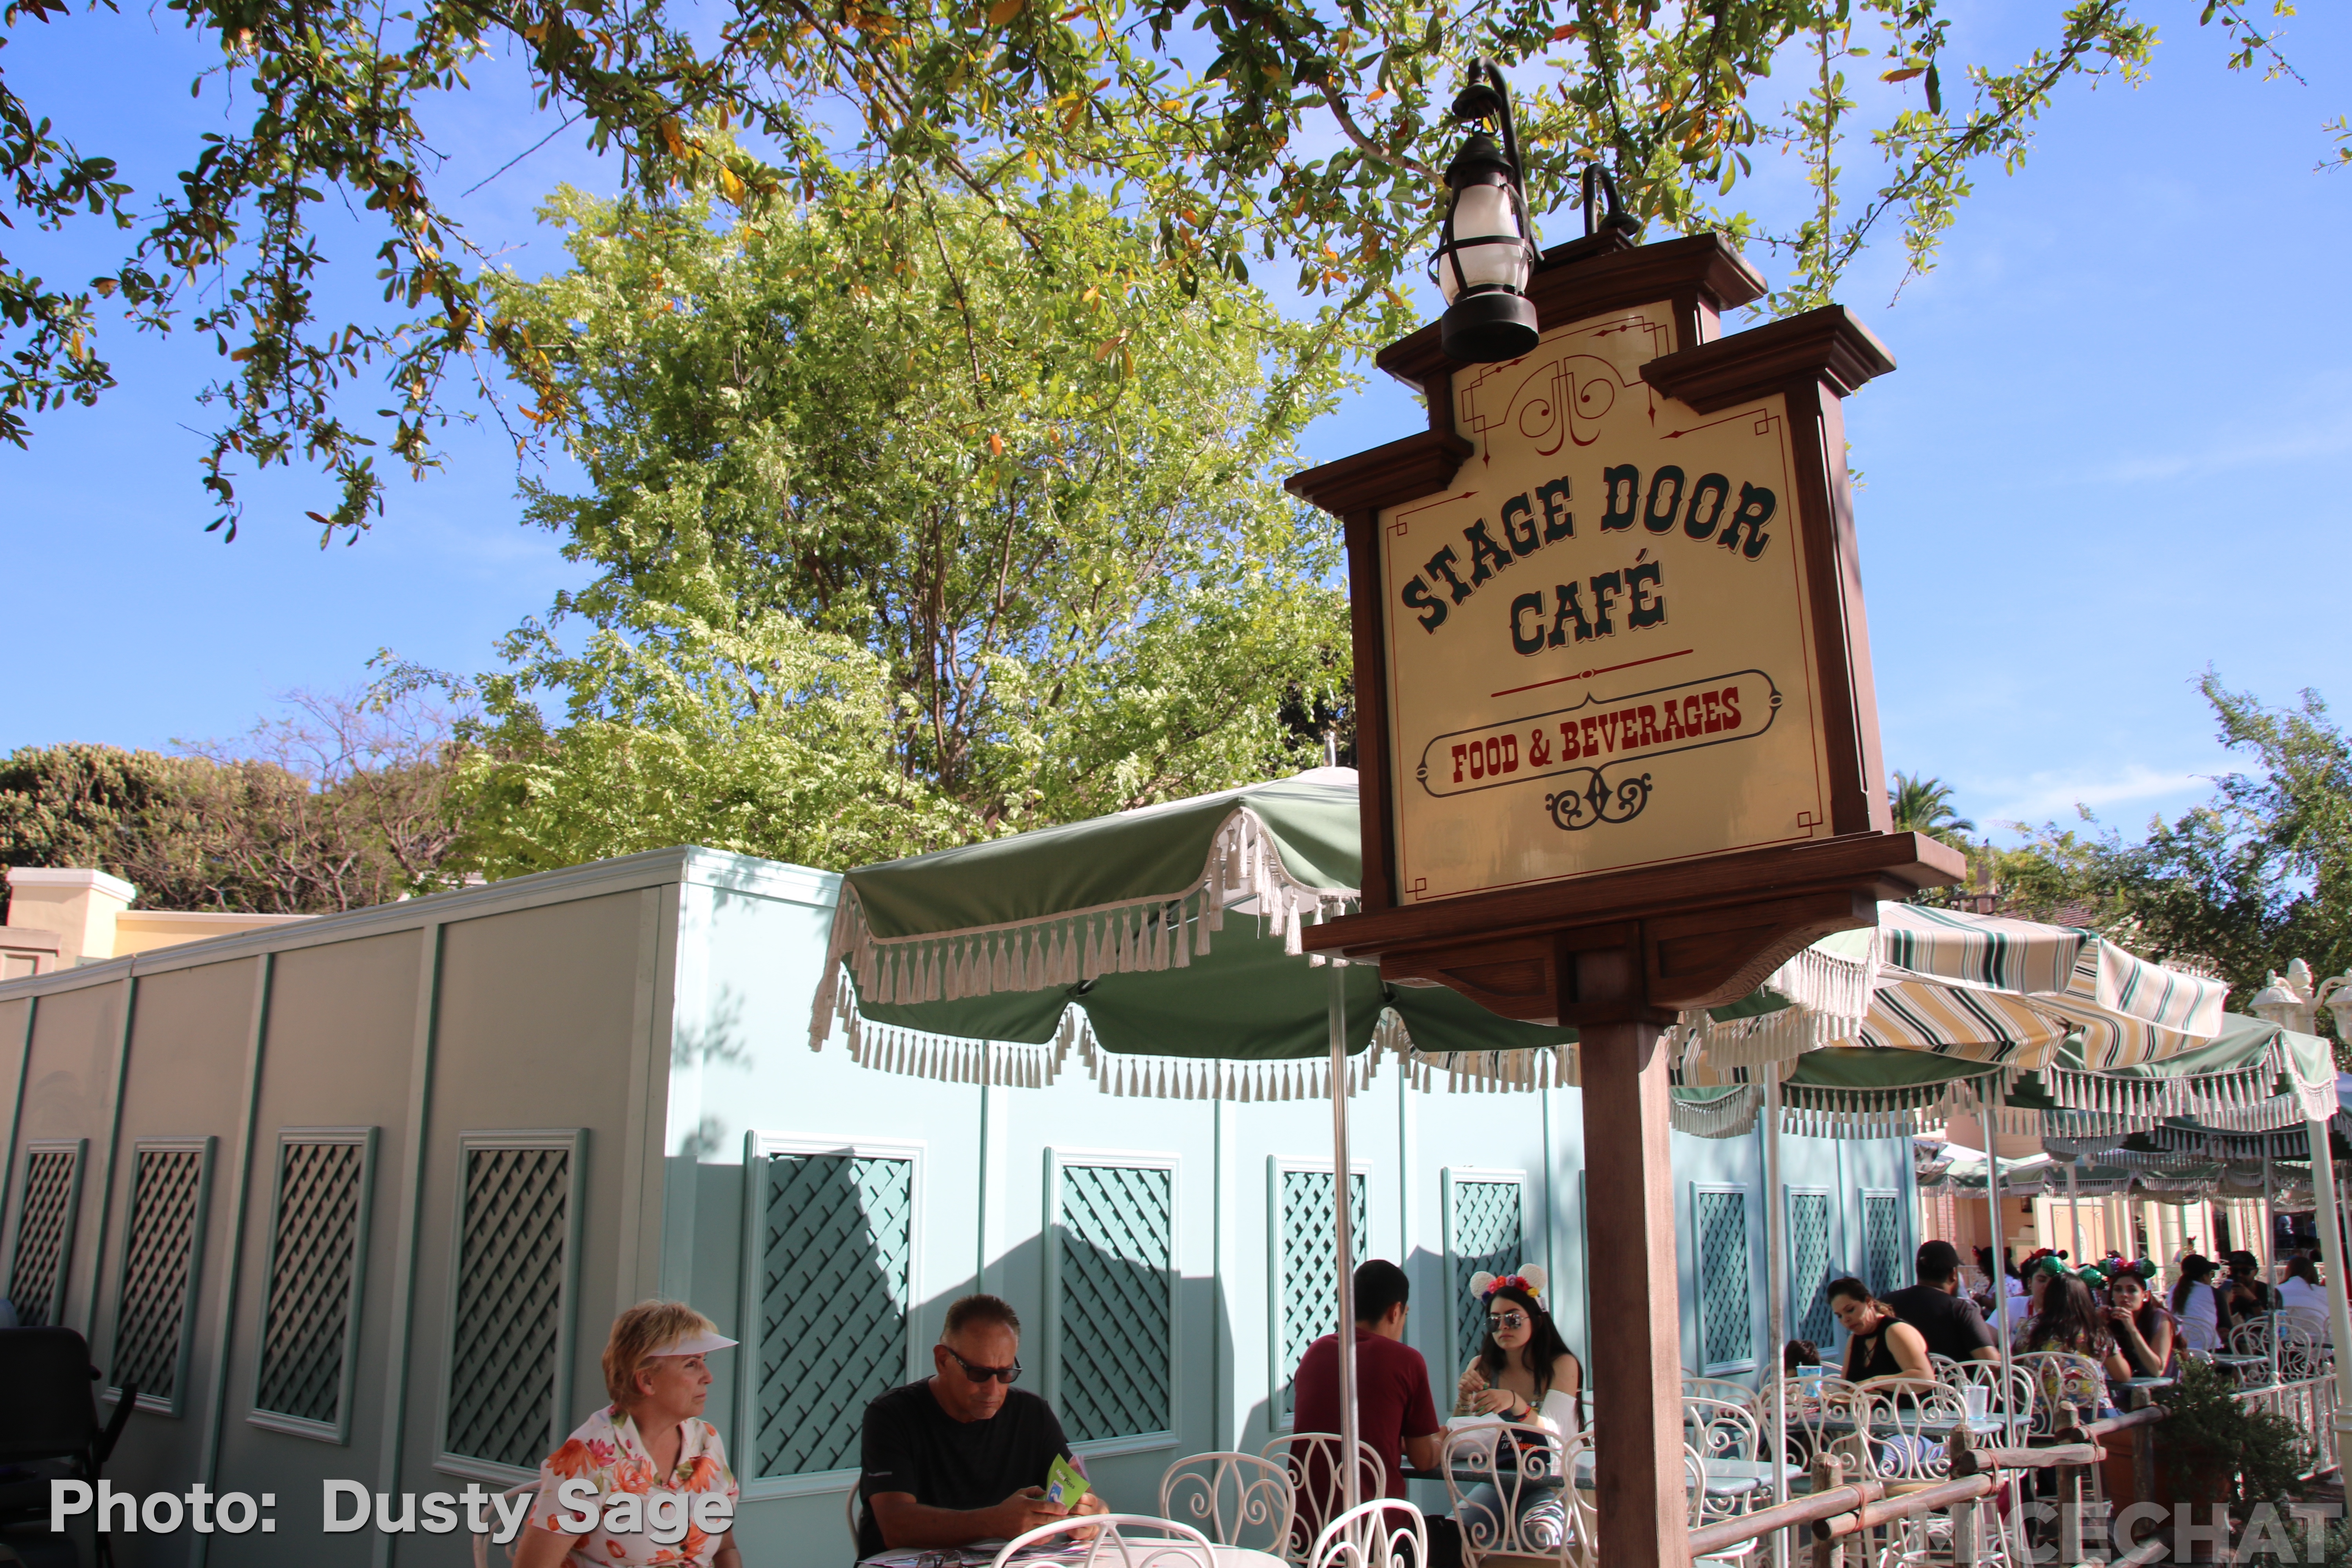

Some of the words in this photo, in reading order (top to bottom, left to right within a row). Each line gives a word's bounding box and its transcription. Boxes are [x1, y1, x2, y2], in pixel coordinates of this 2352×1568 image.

[1401, 475, 1576, 635] STAGE
[1601, 463, 1778, 561] DOOR
[1509, 548, 1667, 657] CAFÉ
[1451, 734, 1519, 784] FOOD
[1529, 729, 1553, 768] &
[1559, 687, 1742, 762] BEVERAGES
[1056, 1468, 1075, 1489] MaxPass
